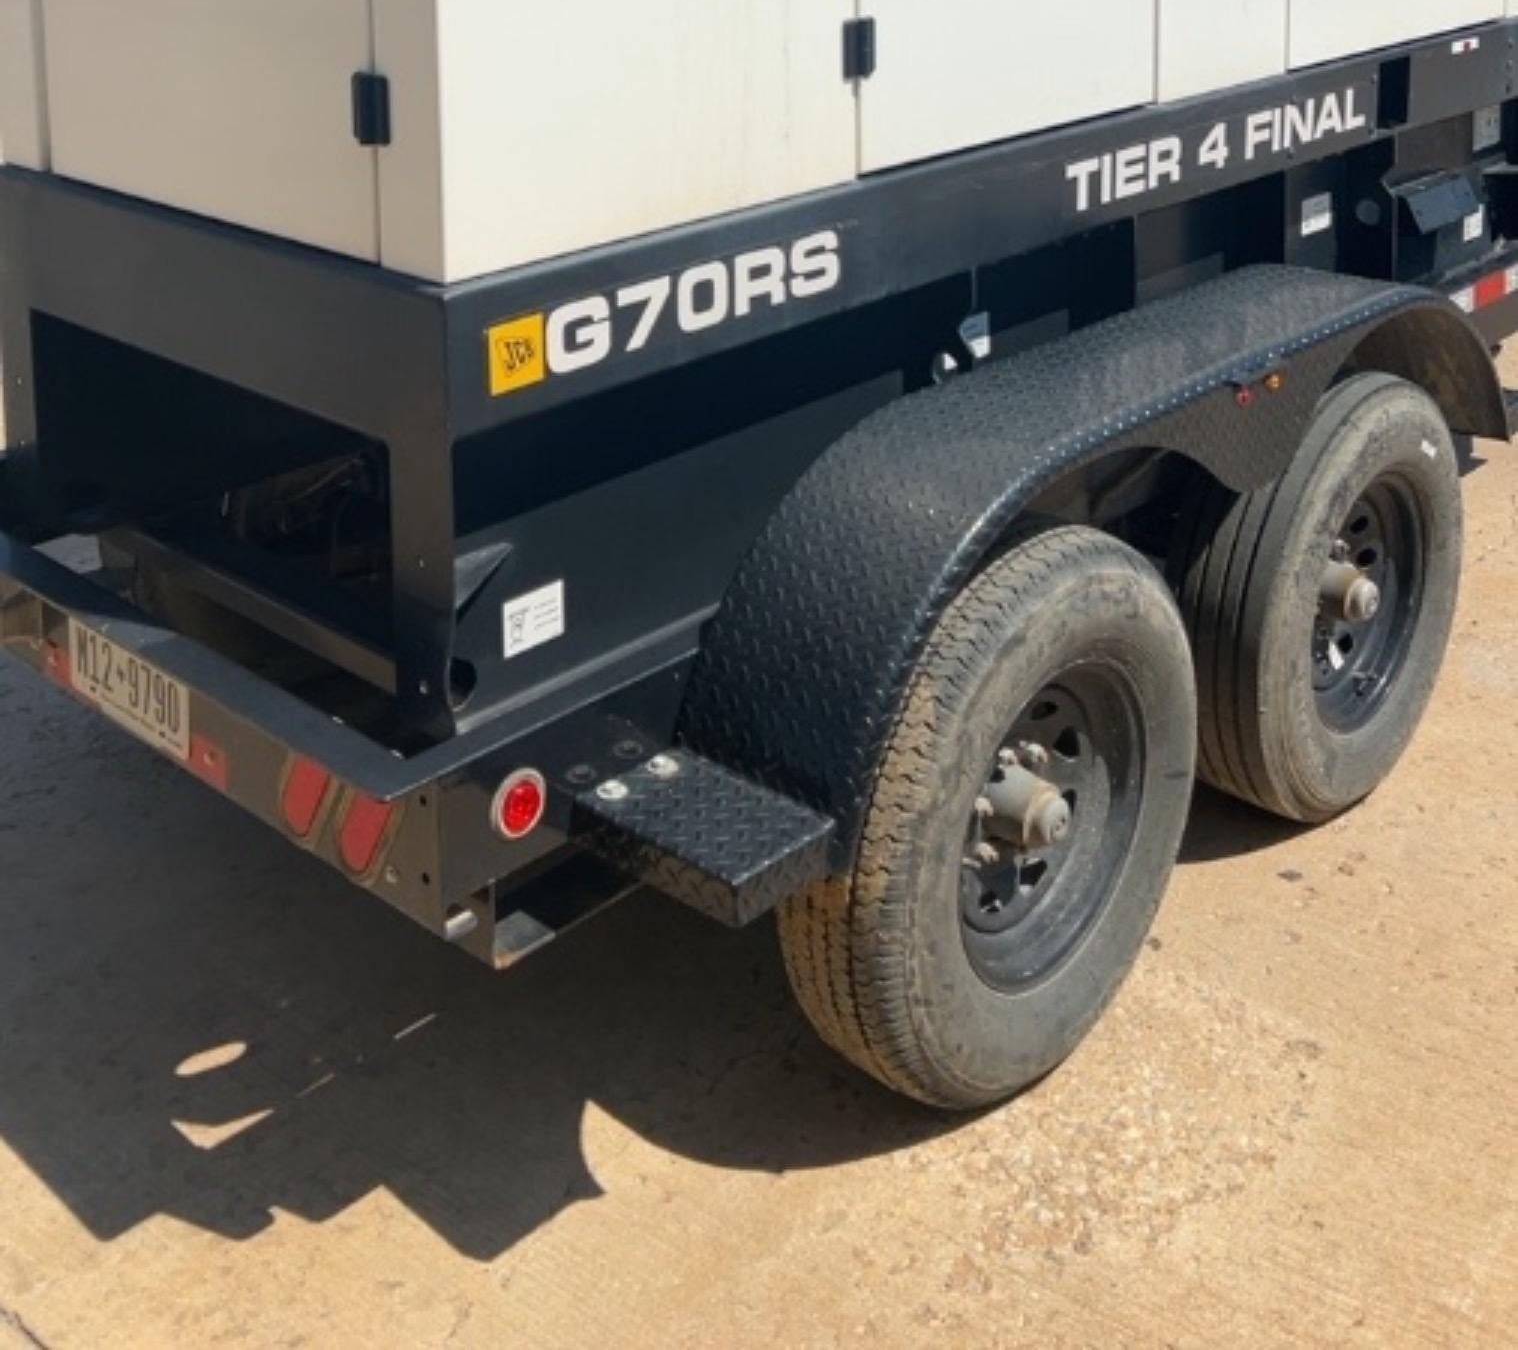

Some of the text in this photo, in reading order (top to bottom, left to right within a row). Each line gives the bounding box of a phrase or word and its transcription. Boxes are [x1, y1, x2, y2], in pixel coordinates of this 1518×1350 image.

[1065, 87, 1367, 212] TIER 4 FINAL
[545, 230, 841, 374] G70RS
